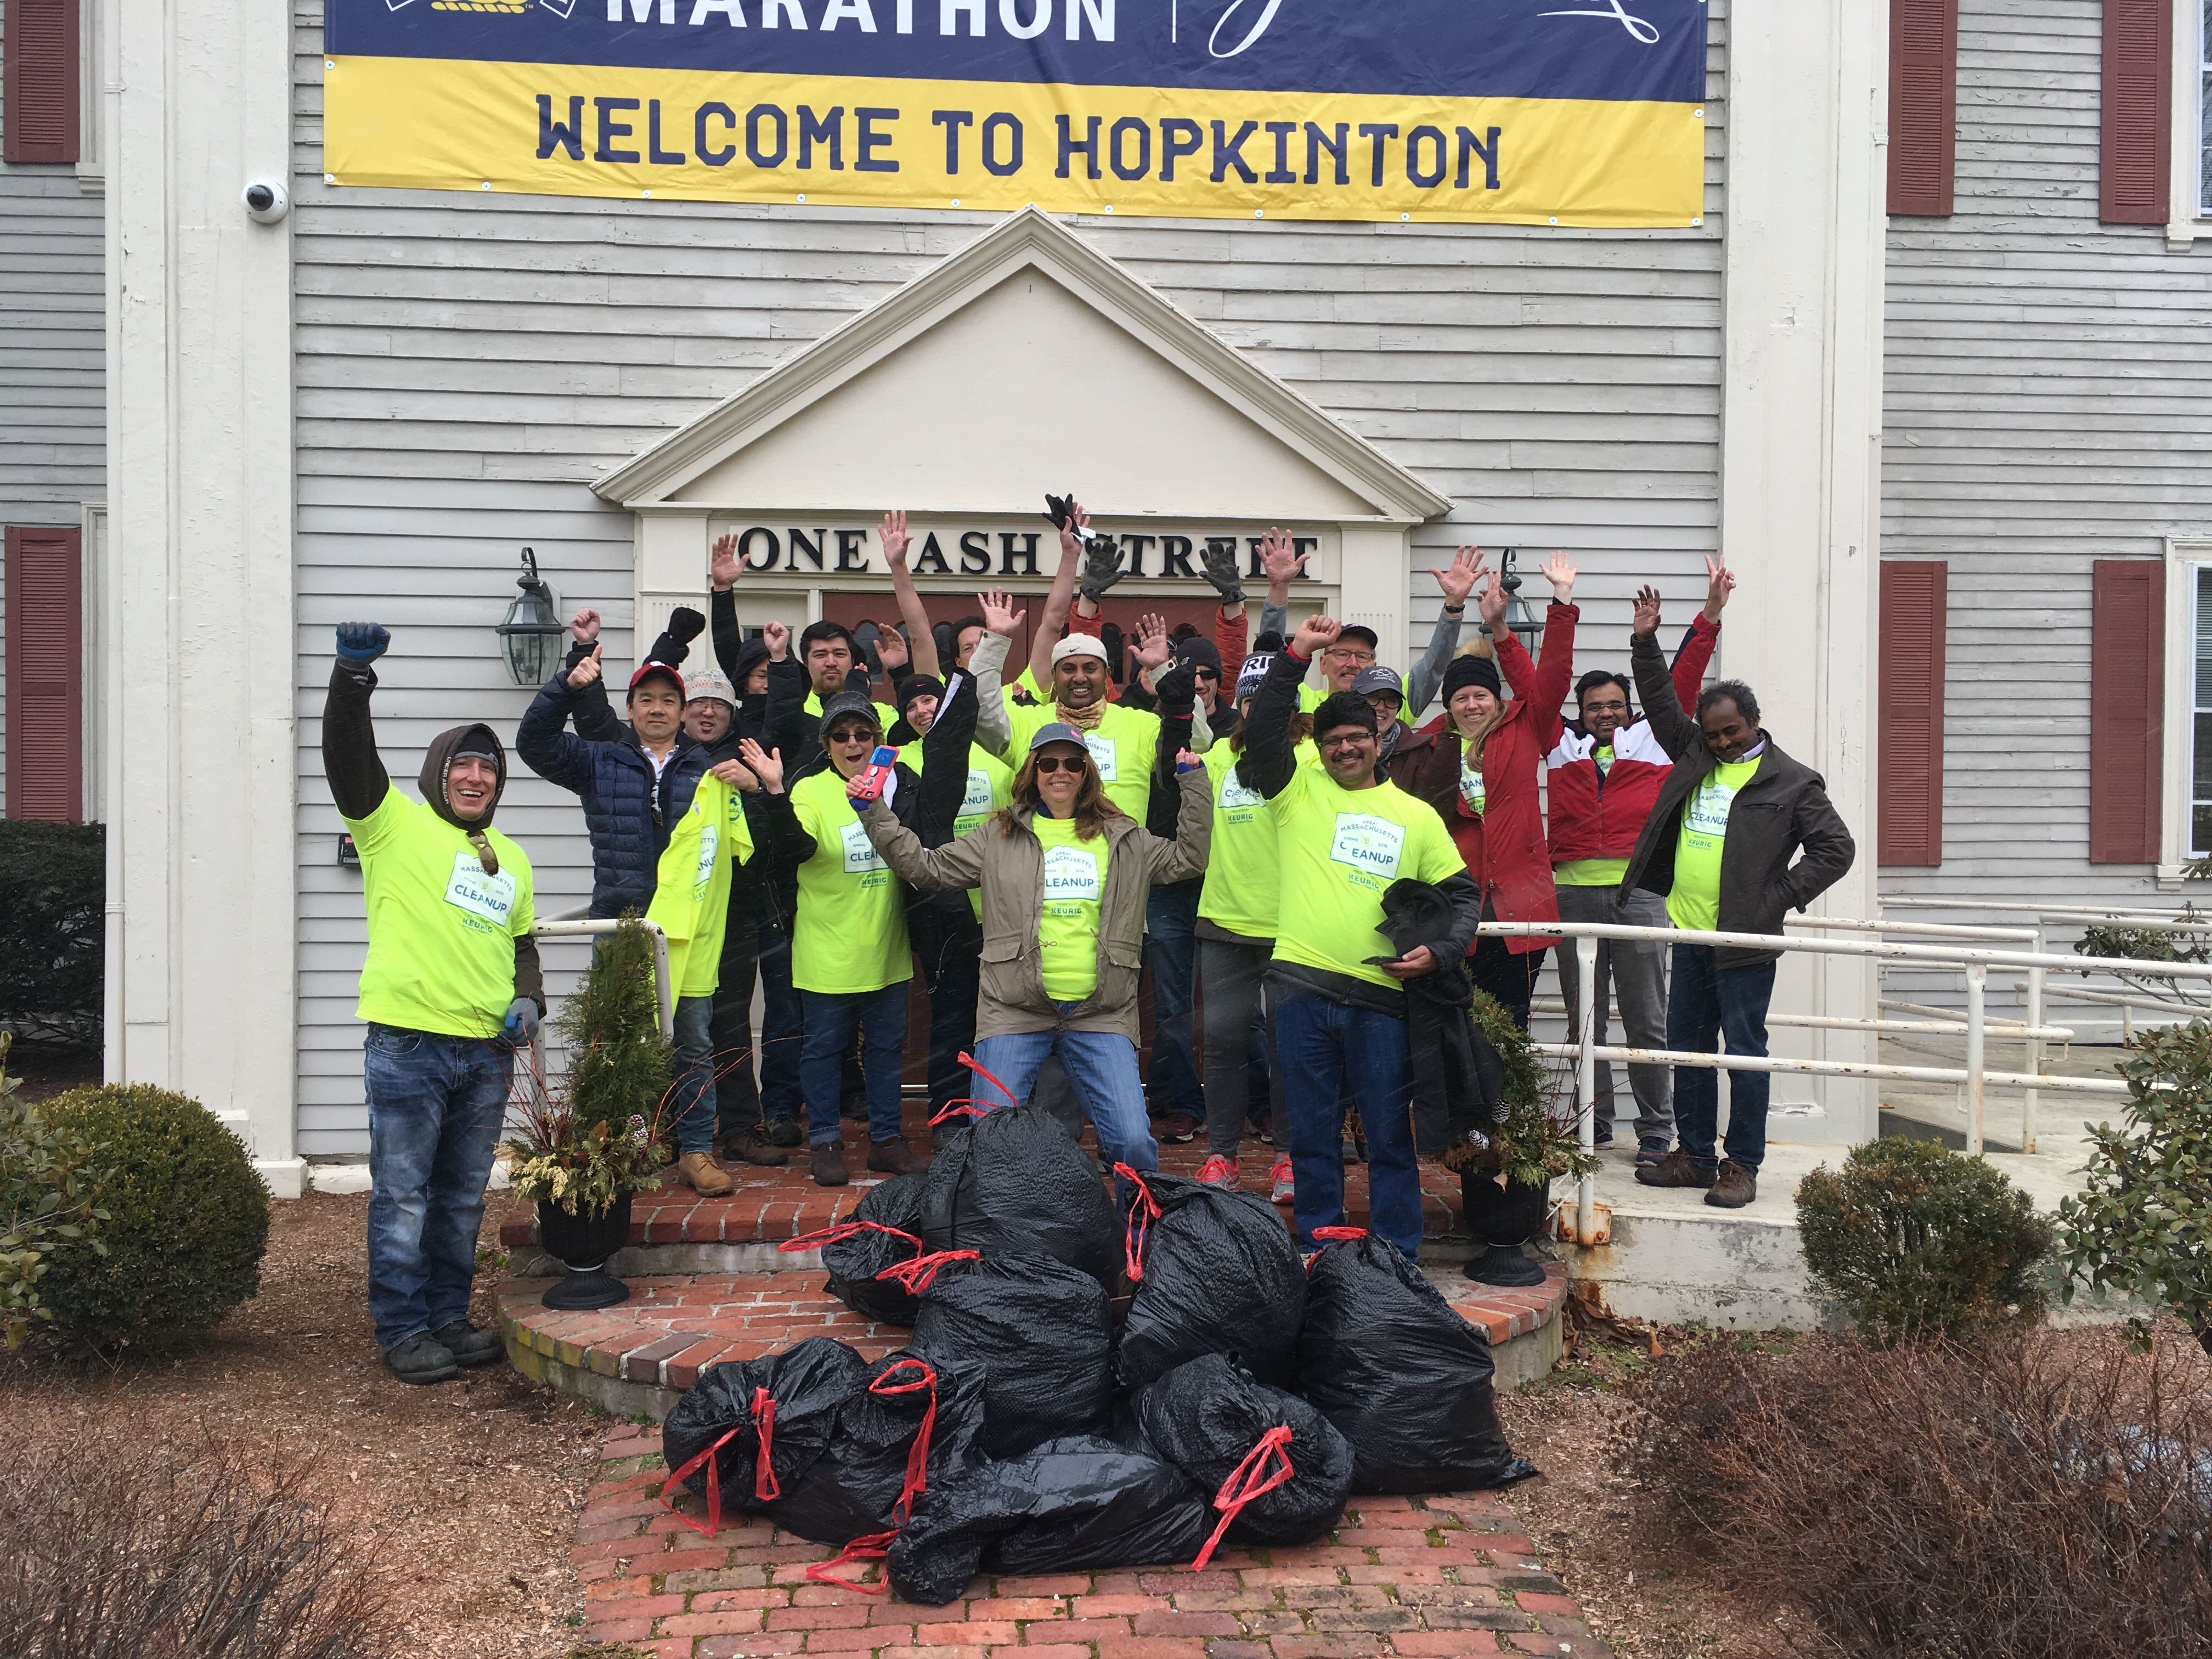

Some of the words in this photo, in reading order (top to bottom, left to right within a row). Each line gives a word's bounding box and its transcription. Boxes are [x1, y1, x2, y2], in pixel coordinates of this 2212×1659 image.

[535, 94, 900, 172] WELCOME
[932, 110, 1024, 176] TO
[1054, 114, 1502, 189] HOPKINTON
[739, 527, 870, 573] ONE
[912, 531, 1042, 575] ASH
[1084, 533, 1317, 579] TRET
[1341, 823, 1398, 843] MASSACHUSETTS
[1689, 839, 1712, 848] KEURIG
[1340, 841, 1393, 865] CEANUP
[454, 884, 507, 912] CLEANUP
